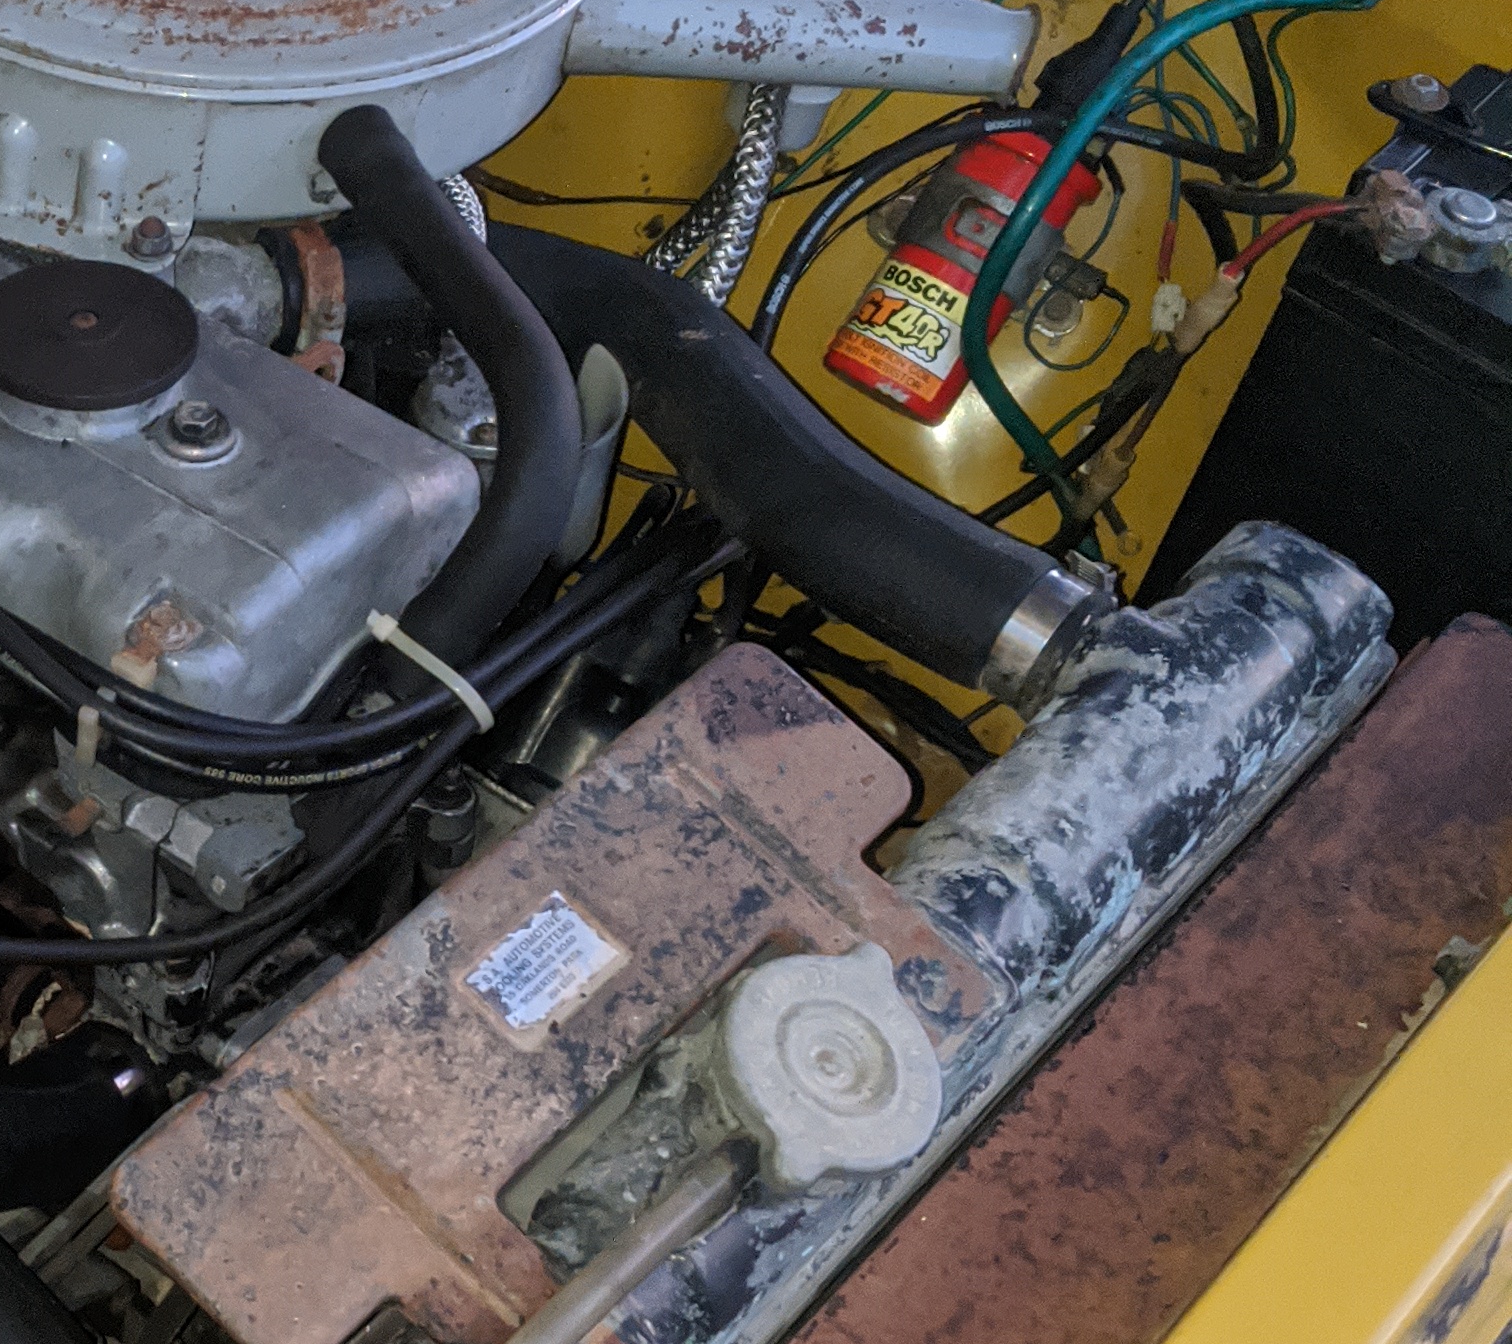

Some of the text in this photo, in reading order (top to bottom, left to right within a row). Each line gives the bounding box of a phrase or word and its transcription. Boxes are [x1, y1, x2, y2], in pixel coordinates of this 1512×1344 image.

[883, 264, 959, 313] BOSCH
[227, 770, 262, 785] CORE
[263, 772, 326, 786] INDUCTIVE
[494, 957, 533, 993] OOLING
[530, 919, 576, 959] SYSTEMS
[502, 914, 562, 968] AUTOMOTIVE
